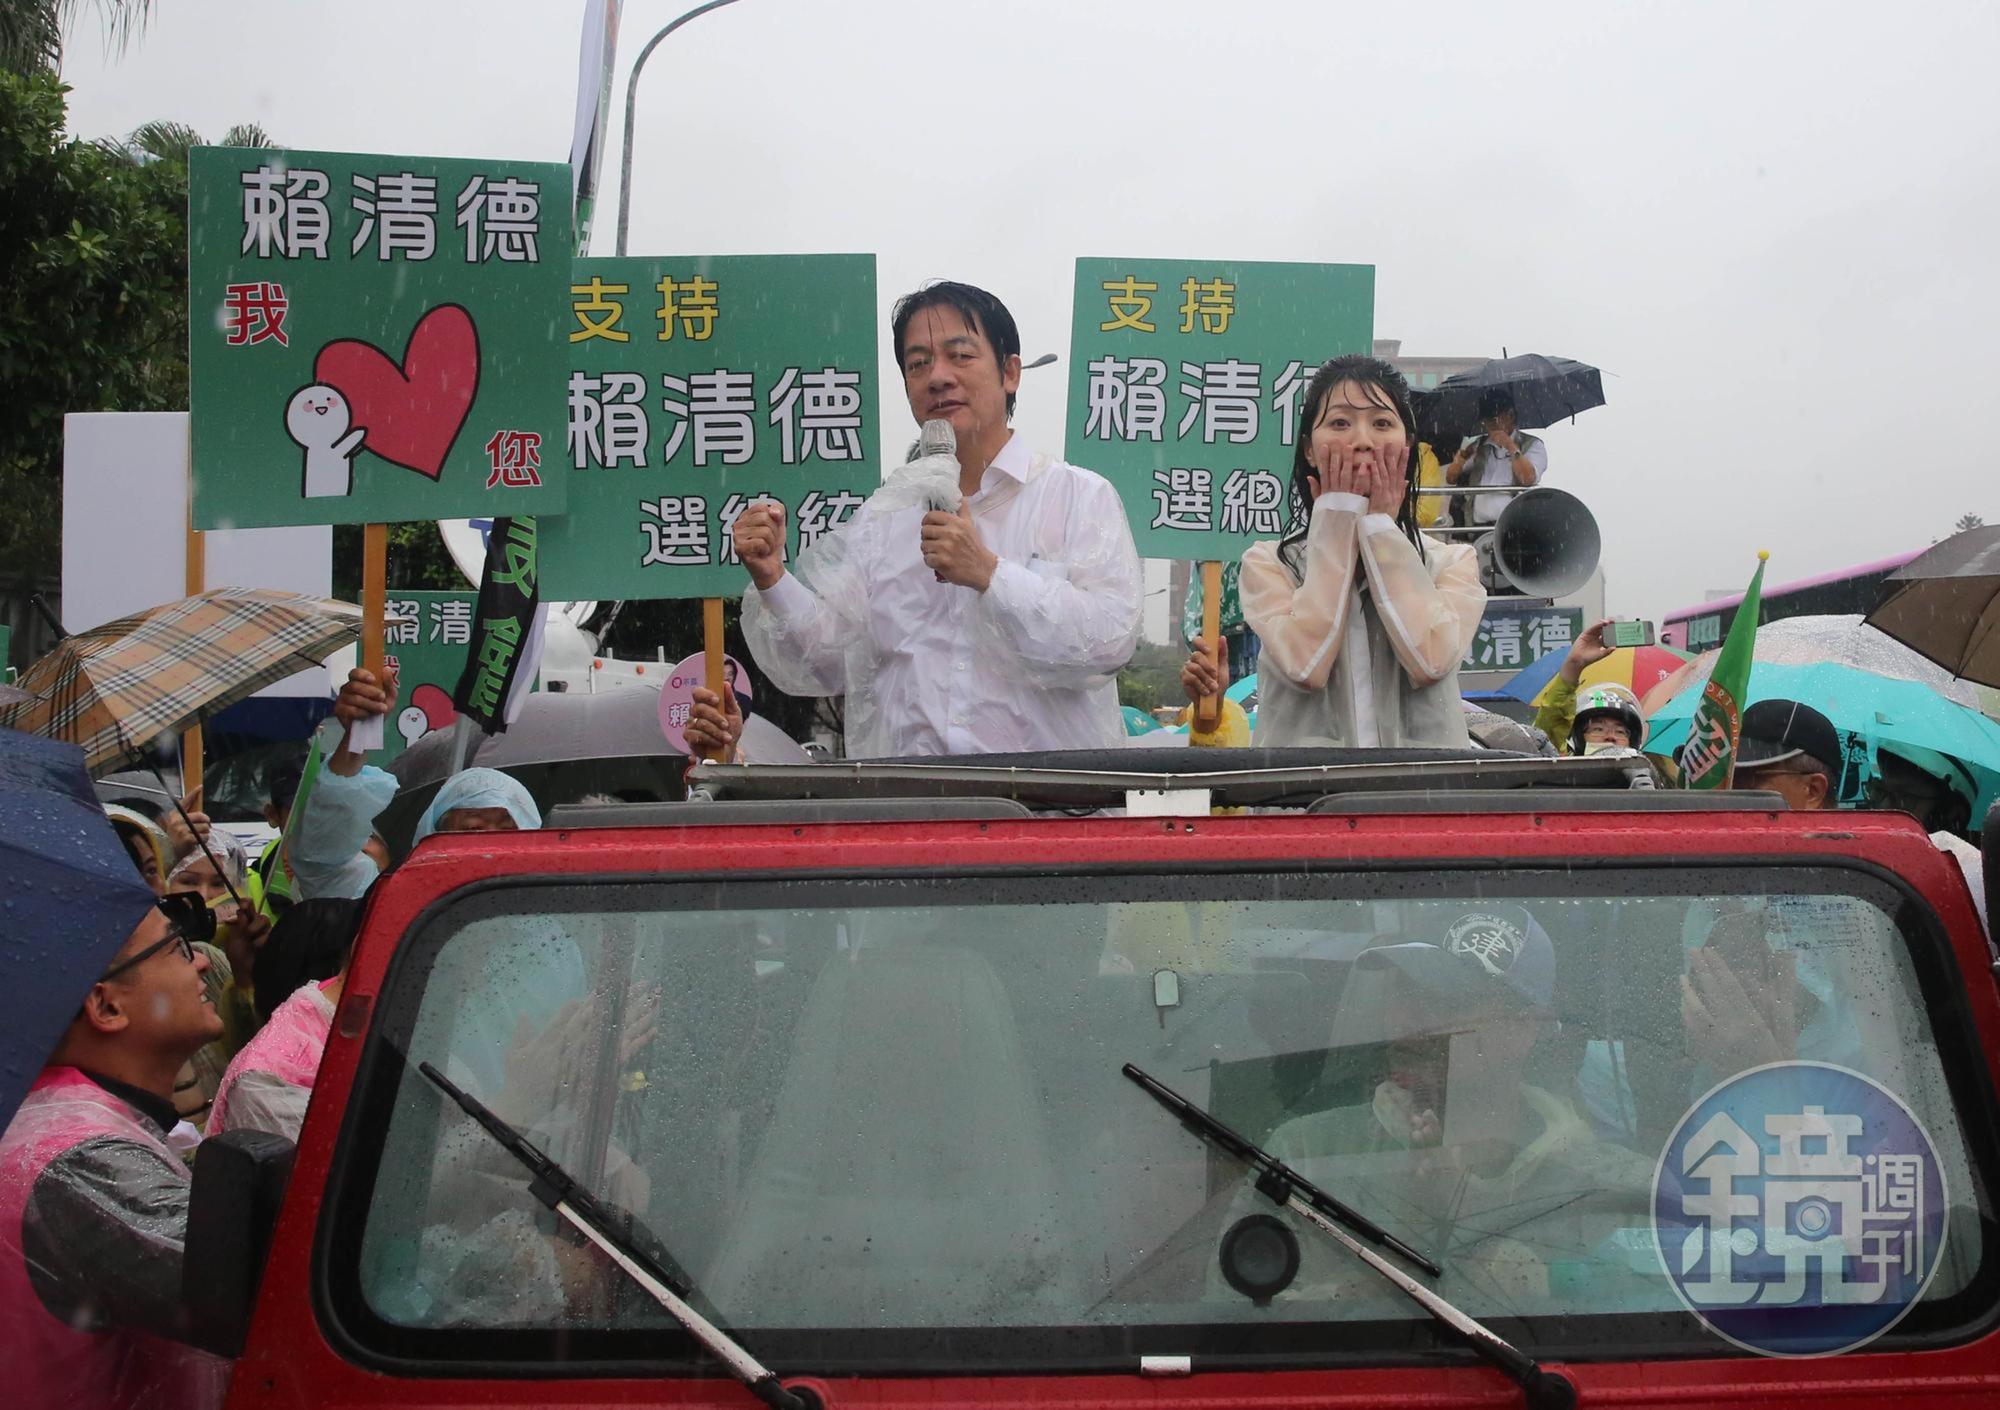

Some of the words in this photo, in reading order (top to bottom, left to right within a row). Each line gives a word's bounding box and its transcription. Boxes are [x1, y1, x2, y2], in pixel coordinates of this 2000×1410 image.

[239, 165, 540, 264] 賴清德
[224, 281, 290, 347] 我
[570, 275, 720, 343] 支持
[1100, 275, 1236, 334] 支持
[567, 367, 864, 469] 賴清德
[485, 429, 542, 489] 您
[1151, 468, 1306, 534] 選總
[1463, 615, 1572, 665] 清德
